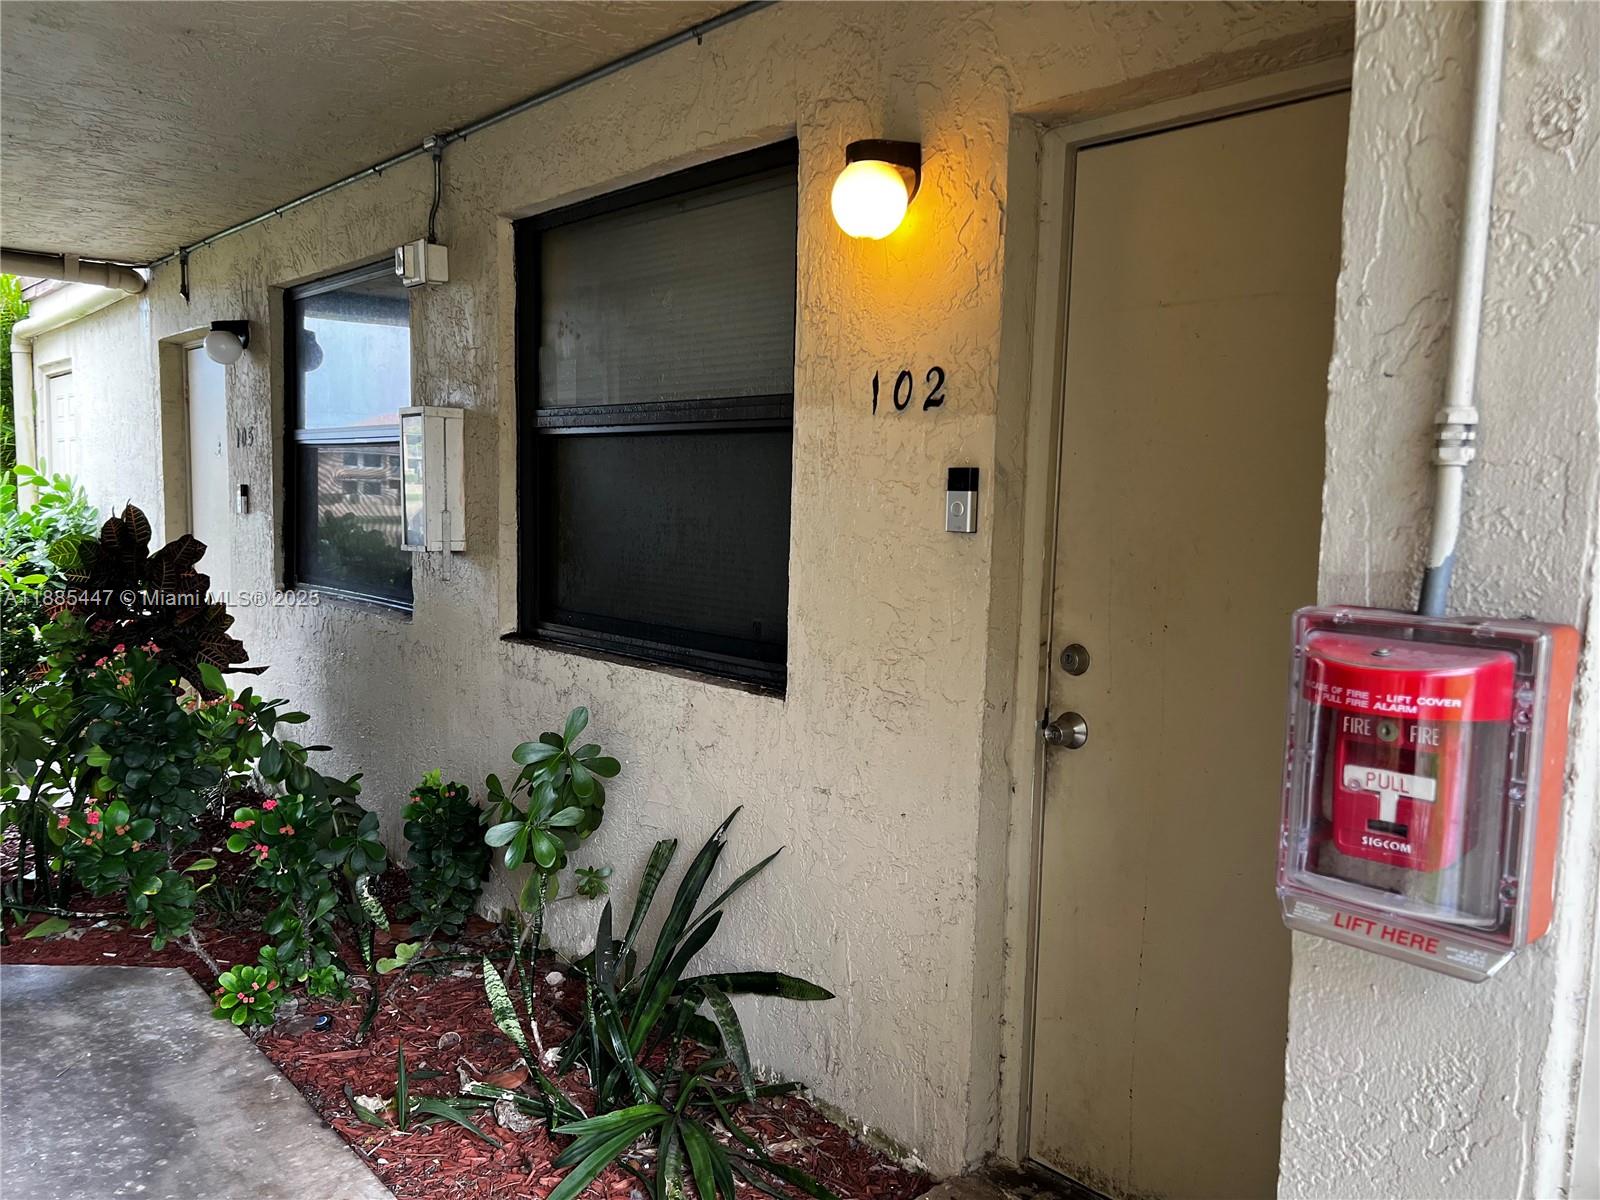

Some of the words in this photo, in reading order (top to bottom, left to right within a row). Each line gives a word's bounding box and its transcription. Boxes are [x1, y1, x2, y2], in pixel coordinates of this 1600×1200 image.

[872, 366, 945, 415] 102
[1345, 697, 1369, 709] FIRE
[1372, 702, 1418, 714] ALARM
[1346, 688, 1369, 700] FIRE
[1386, 694, 1412, 704] LIFT
[1416, 697, 1462, 708] COVER
[1343, 716, 1372, 736] FIRE
[1410, 725, 1440, 746] FIRE
[1366, 772, 1410, 794] PULL
[1361, 836, 1412, 854] SIGCOM
[1333, 912, 1377, 936] LIFT
[1380, 925, 1440, 954] HERE
